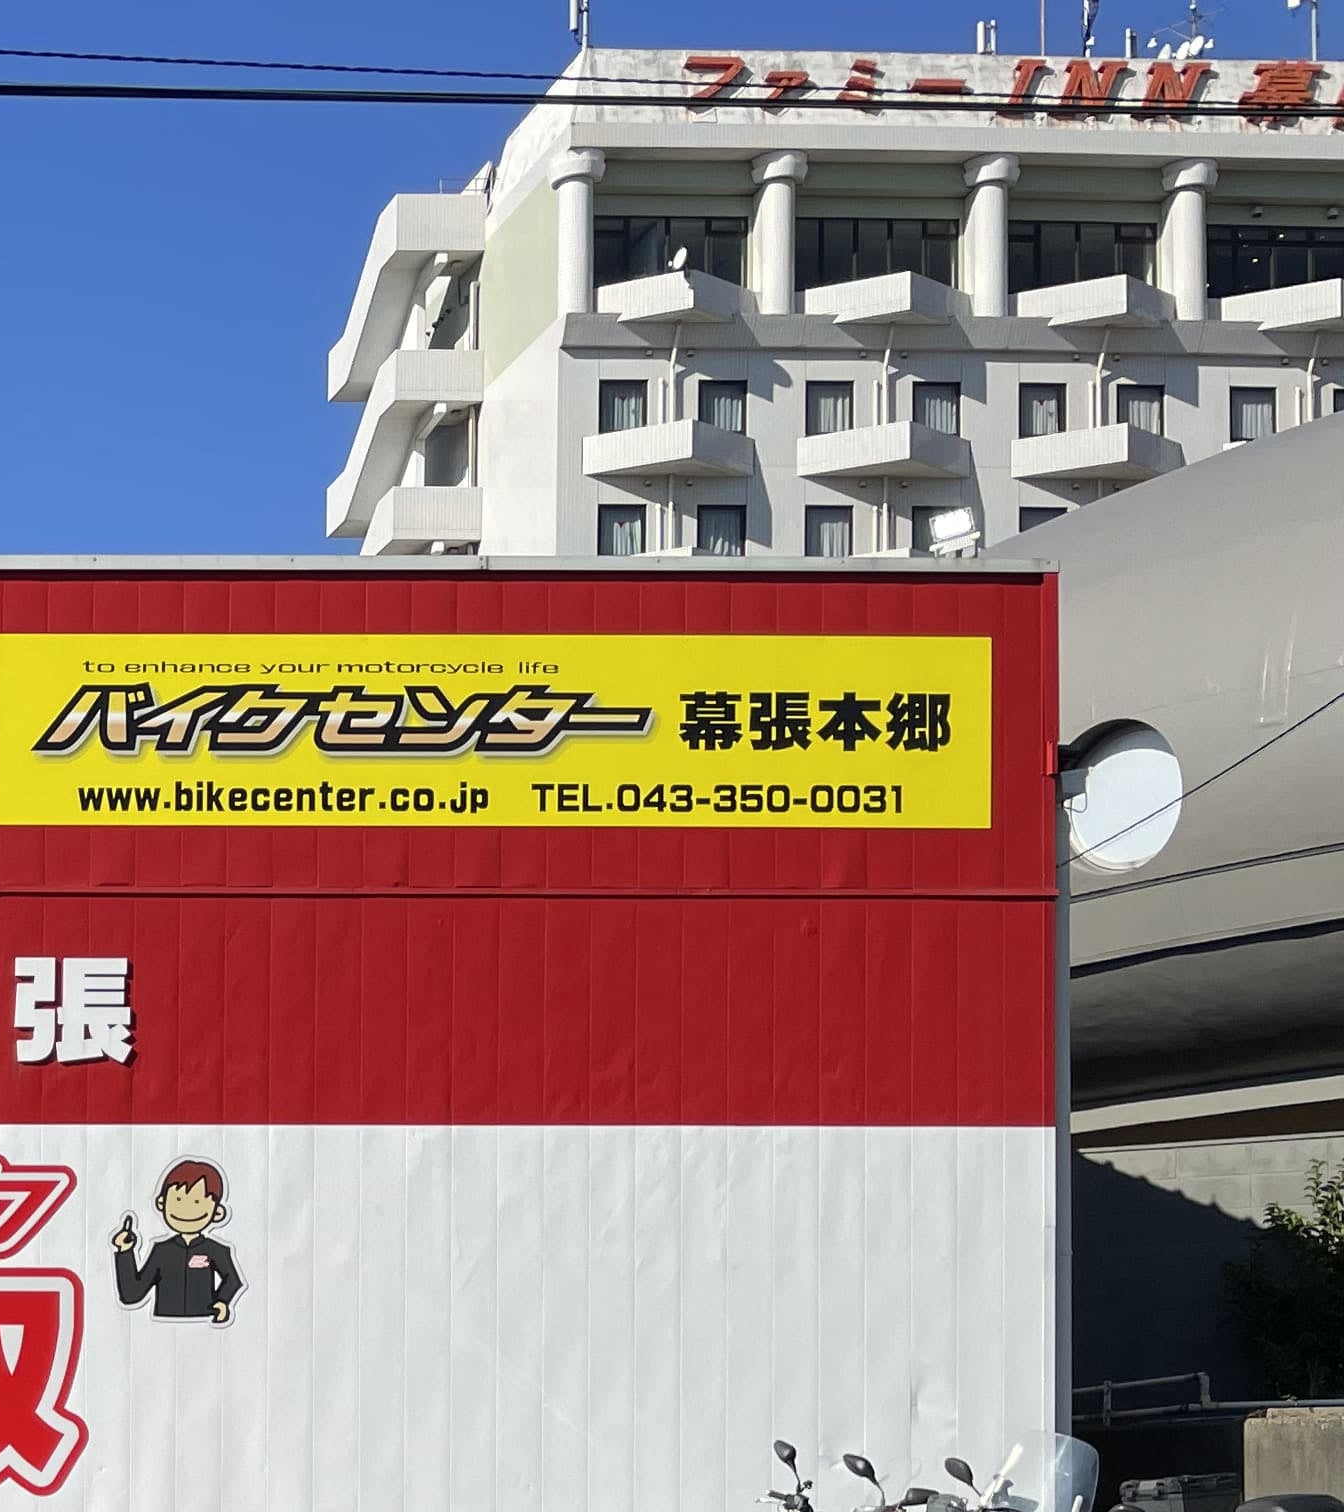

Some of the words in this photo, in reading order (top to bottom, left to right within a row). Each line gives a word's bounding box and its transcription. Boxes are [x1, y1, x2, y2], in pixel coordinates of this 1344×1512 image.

[82, 660, 116, 674] to
[124, 660, 251, 674] enhance
[259, 662, 331, 677] your
[337, 661, 505, 677] motorcycle
[518, 661, 560, 675] life
[32, 681, 655, 757] バイクセンター
[678, 690, 953, 753] 幕張本郷
[77, 780, 490, 814] www.bikecenter.co.jp
[530, 782, 904, 814] TEL.043-350-0031
